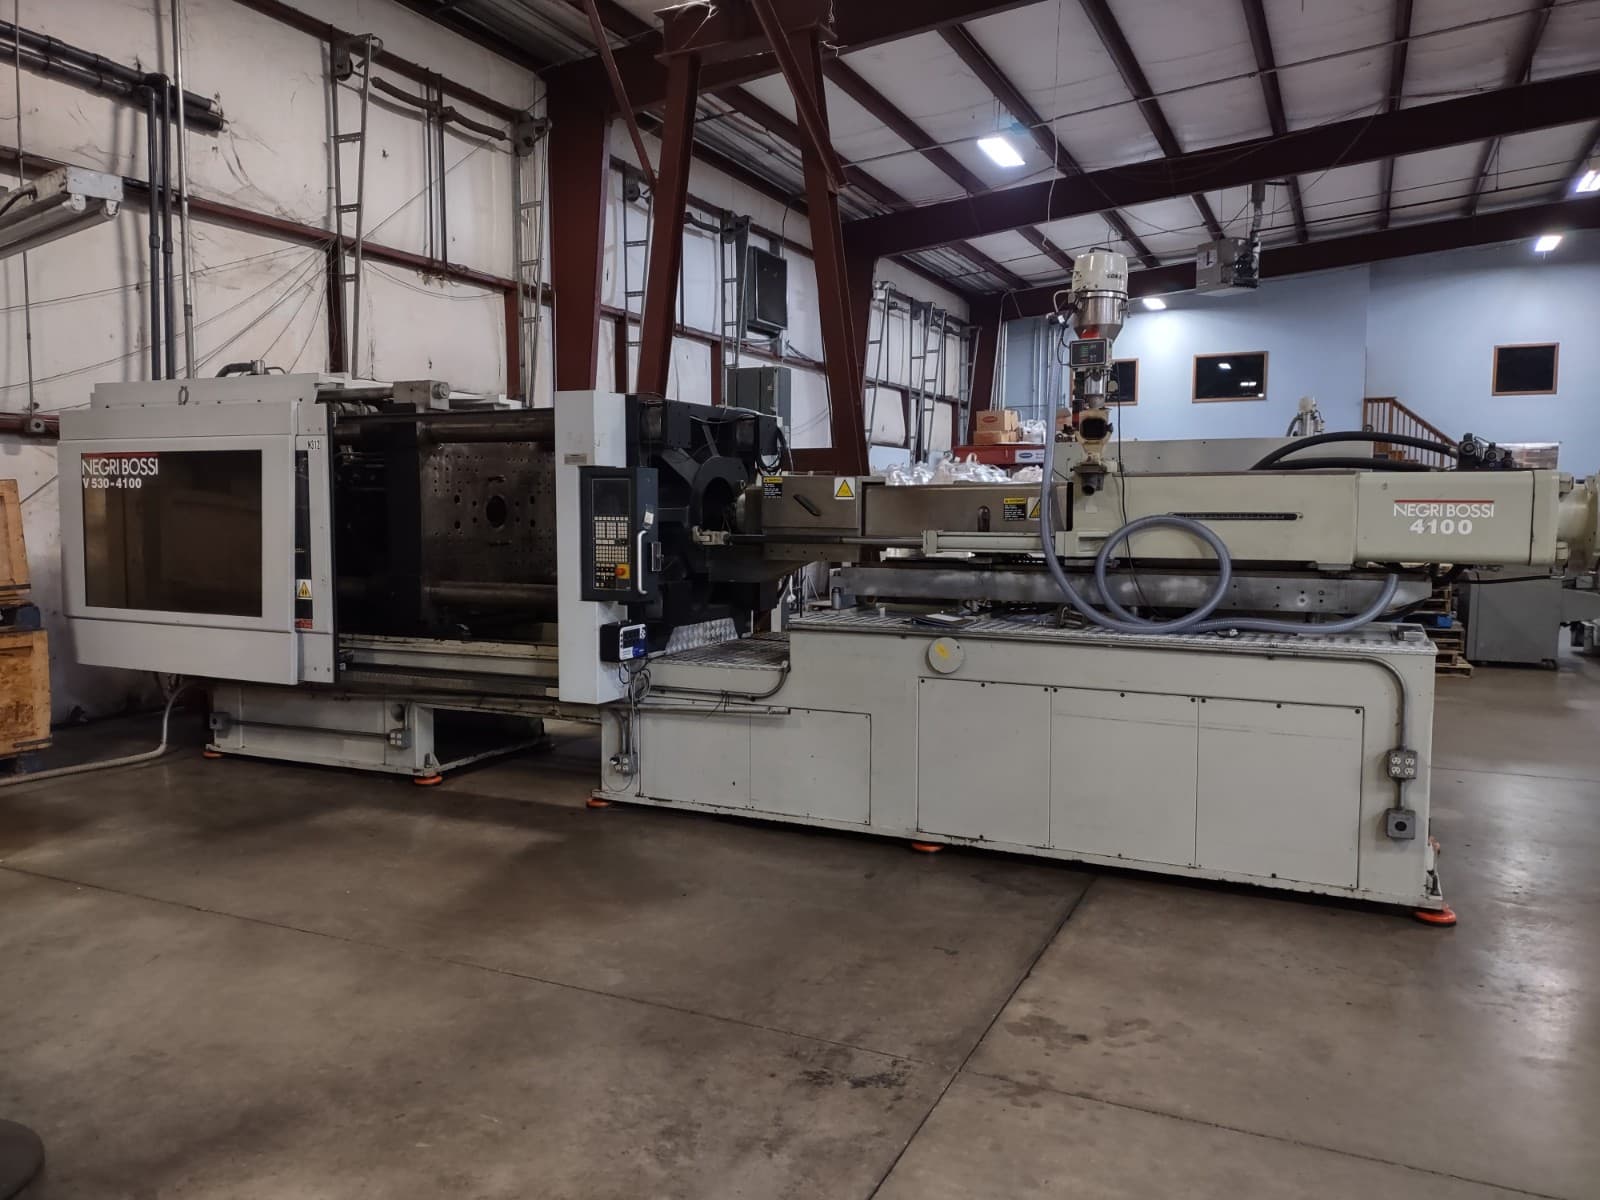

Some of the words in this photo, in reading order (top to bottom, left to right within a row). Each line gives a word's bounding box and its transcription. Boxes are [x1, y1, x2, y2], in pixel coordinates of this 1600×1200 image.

[82, 458, 120, 475] NEGRI
[121, 458, 159, 475] BOSSI
[82, 477, 89, 488] V
[1393, 503, 1443, 517] NEGRI
[1446, 503, 1495, 518] BOSSI
[1409, 518, 1473, 534] 4100
